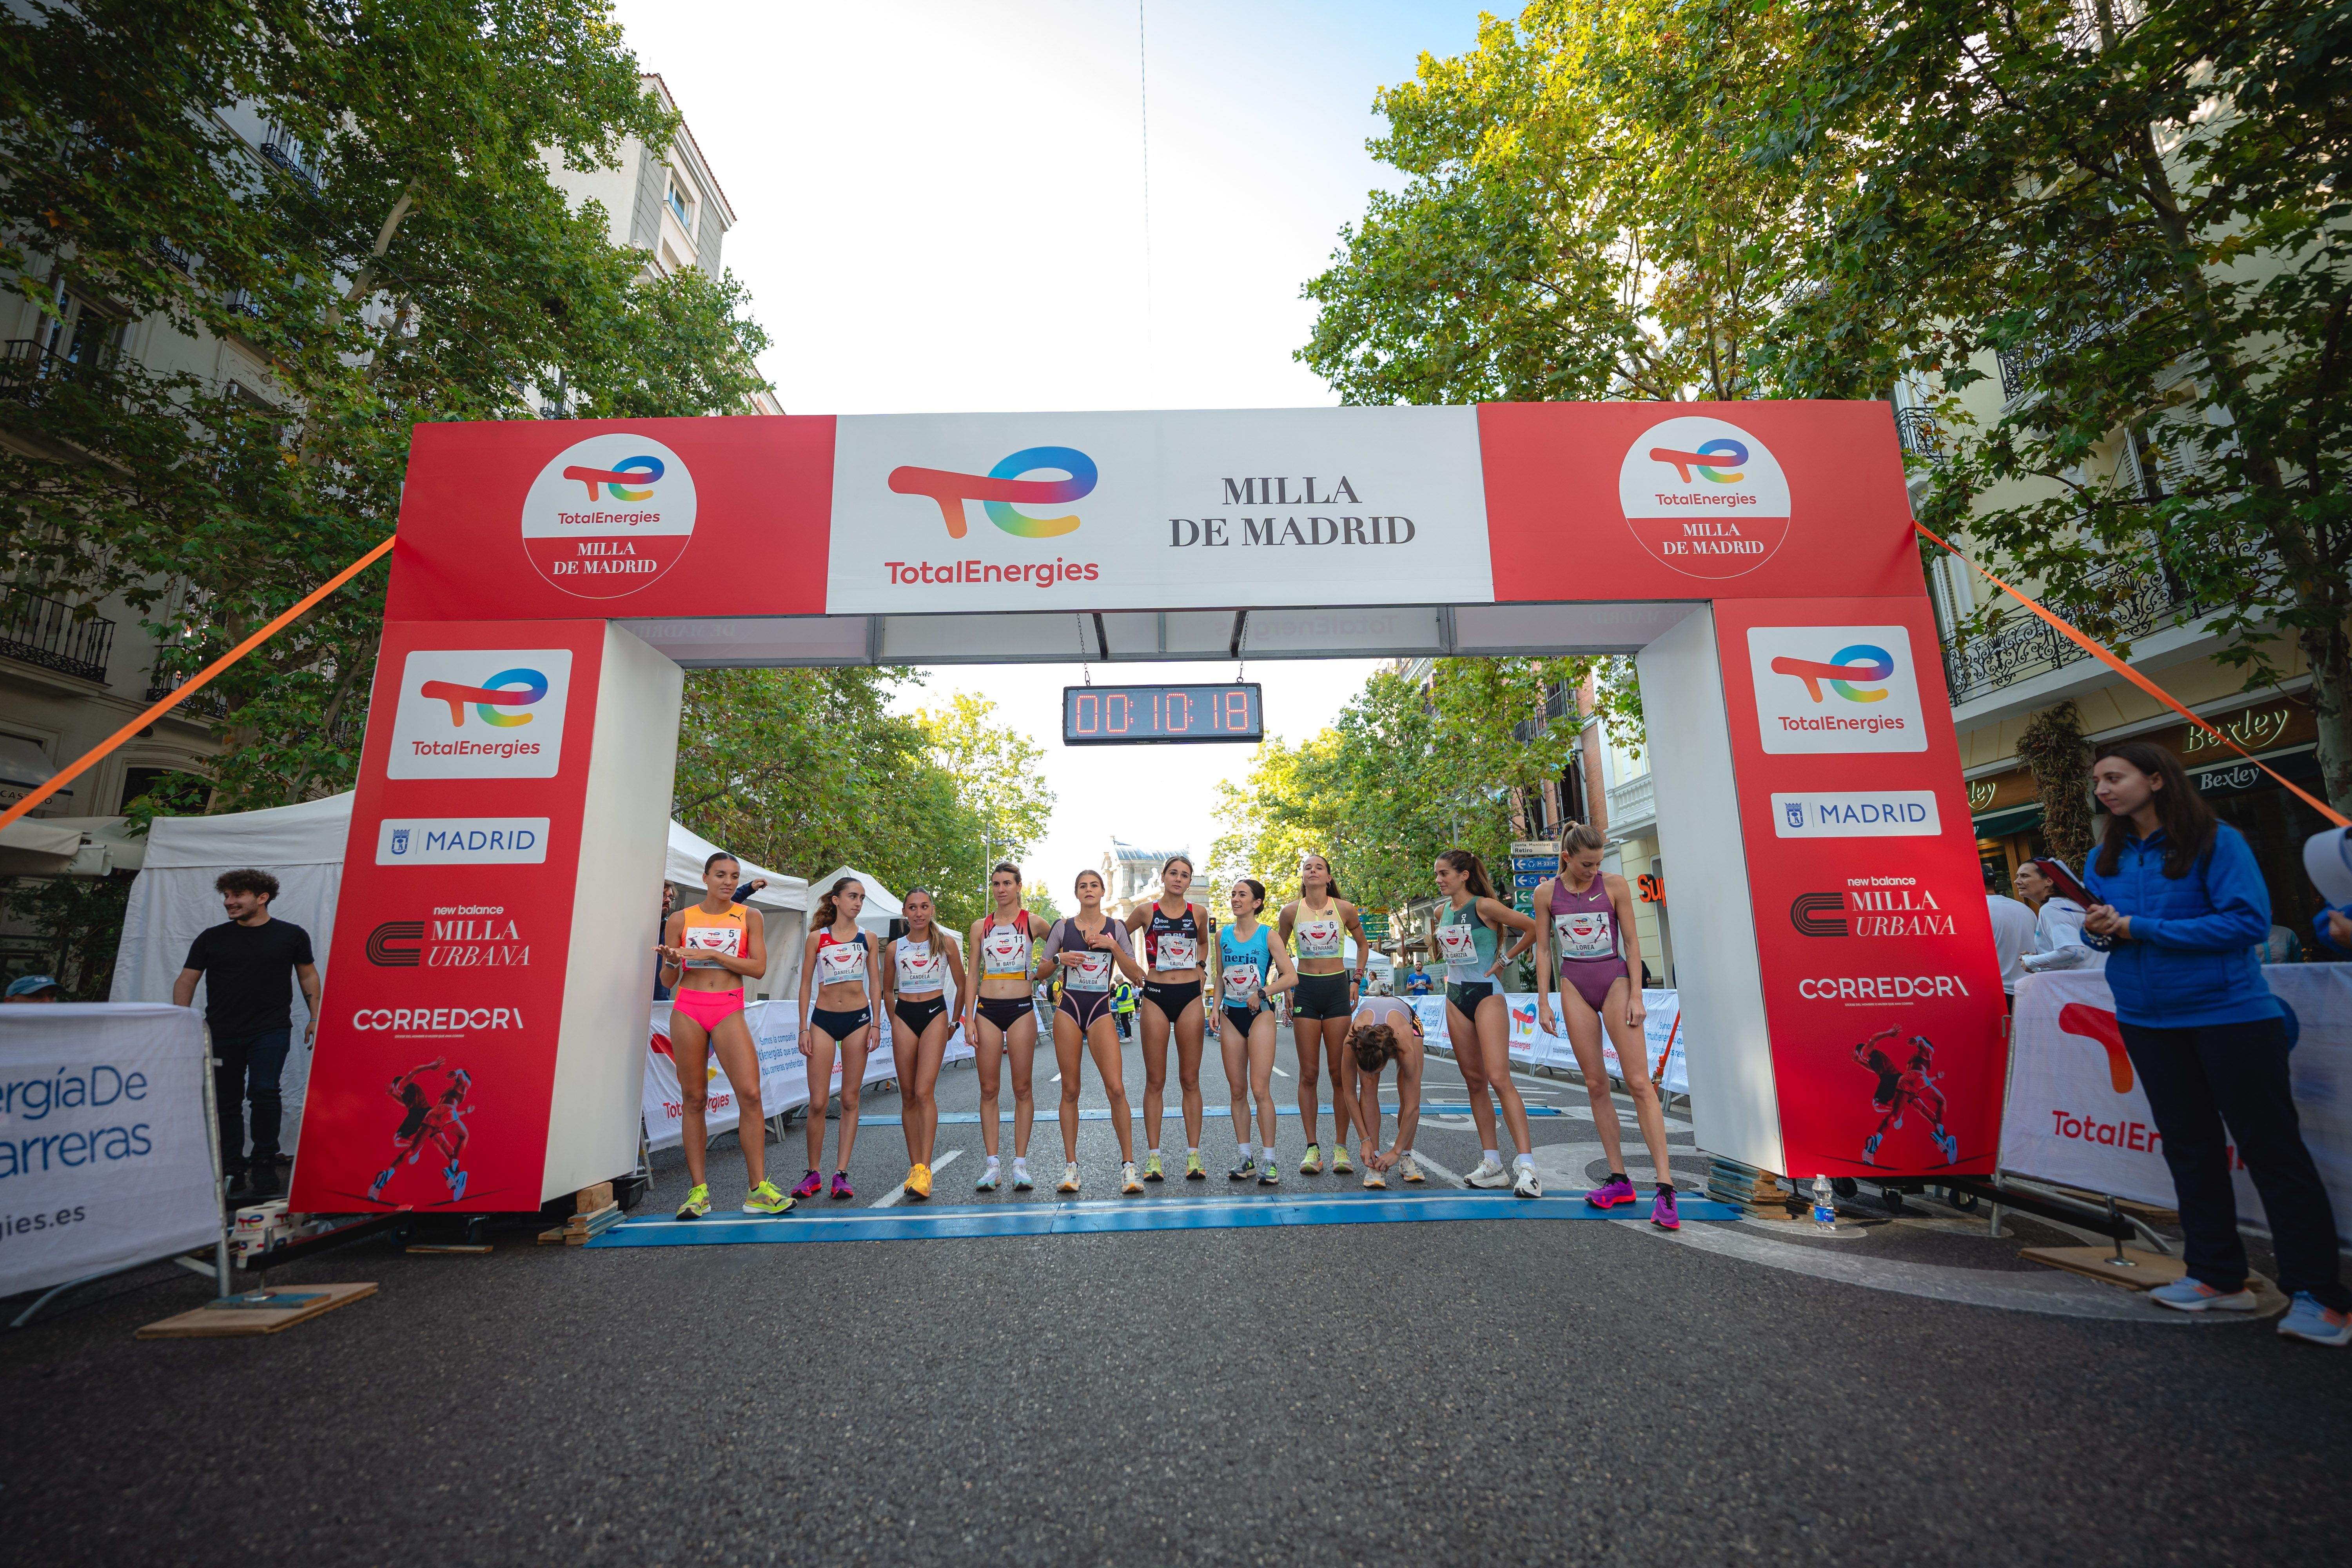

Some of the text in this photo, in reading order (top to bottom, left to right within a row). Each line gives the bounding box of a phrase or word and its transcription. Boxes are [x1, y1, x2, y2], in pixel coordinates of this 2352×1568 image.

[1221, 475, 1362, 506] MILLA
[1655, 493, 1757, 507] TotalEnergies
[557, 510, 661, 526] TotalEnergies
[1169, 515, 1416, 547] DE MADRID
[1683, 523, 1741, 537] MILLA
[577, 541, 636, 556] MILLA
[1663, 540, 1764, 555] DE MADRID
[552, 559, 658, 575] DE MADRID
[884, 557, 1099, 588] TotalEnergies
[1778, 715, 1905, 733] TotalEnergies
[412, 740, 541, 759] TotalEnergies
[2200, 767, 2259, 790] Bexley
[1821, 804, 1926, 824] MADRID
[426, 830, 535, 851] MADRID
[1847, 876, 1916, 886] new balance
[1849, 890, 1940, 911] MILLA
[434, 905, 504, 915] new balance
[1597, 914, 1602, 923] 4
[430, 920, 521, 941] MILLA
[1856, 915, 1957, 936] URBANA
[428, 945, 530, 966] URBANA
[1102, 954, 1107, 962] 2
[1224, 953, 1258, 965] nerja
[760, 1037, 773, 1045] Somos
[777, 1032, 796, 1042] compañía
[762, 1059, 804, 1076] tus carreras preferidas
[0, 1065, 147, 1120] rgíaDe
[0, 1205, 86, 1242] ies.es
